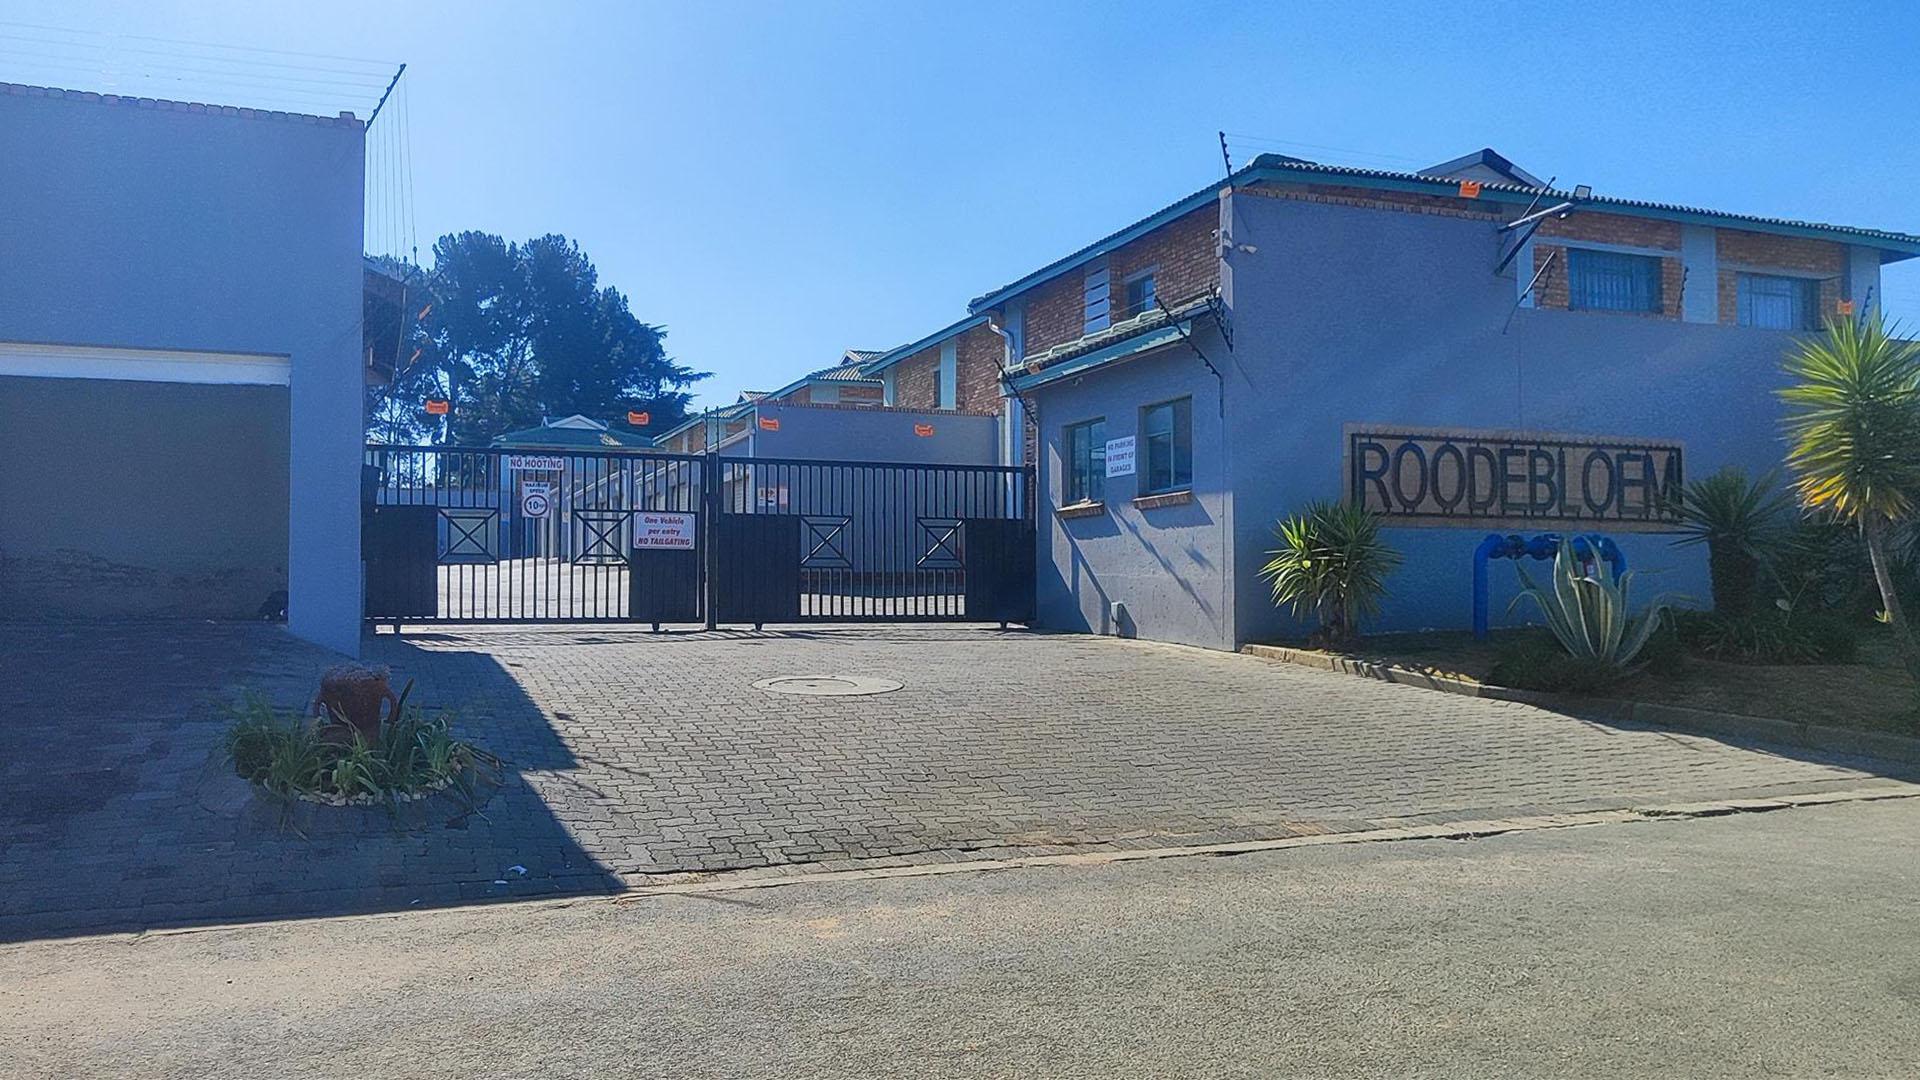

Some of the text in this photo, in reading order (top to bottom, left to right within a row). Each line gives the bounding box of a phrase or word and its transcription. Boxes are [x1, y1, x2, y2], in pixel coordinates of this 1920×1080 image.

[510, 458, 562, 469] NO HOOTING
[1359, 441, 1676, 515] ROODEBLOEM
[528, 501, 538, 509] 10
[660, 517, 684, 525] Vehicle
[662, 528, 681, 536] entry
[650, 538, 691, 546] TAILGATING
